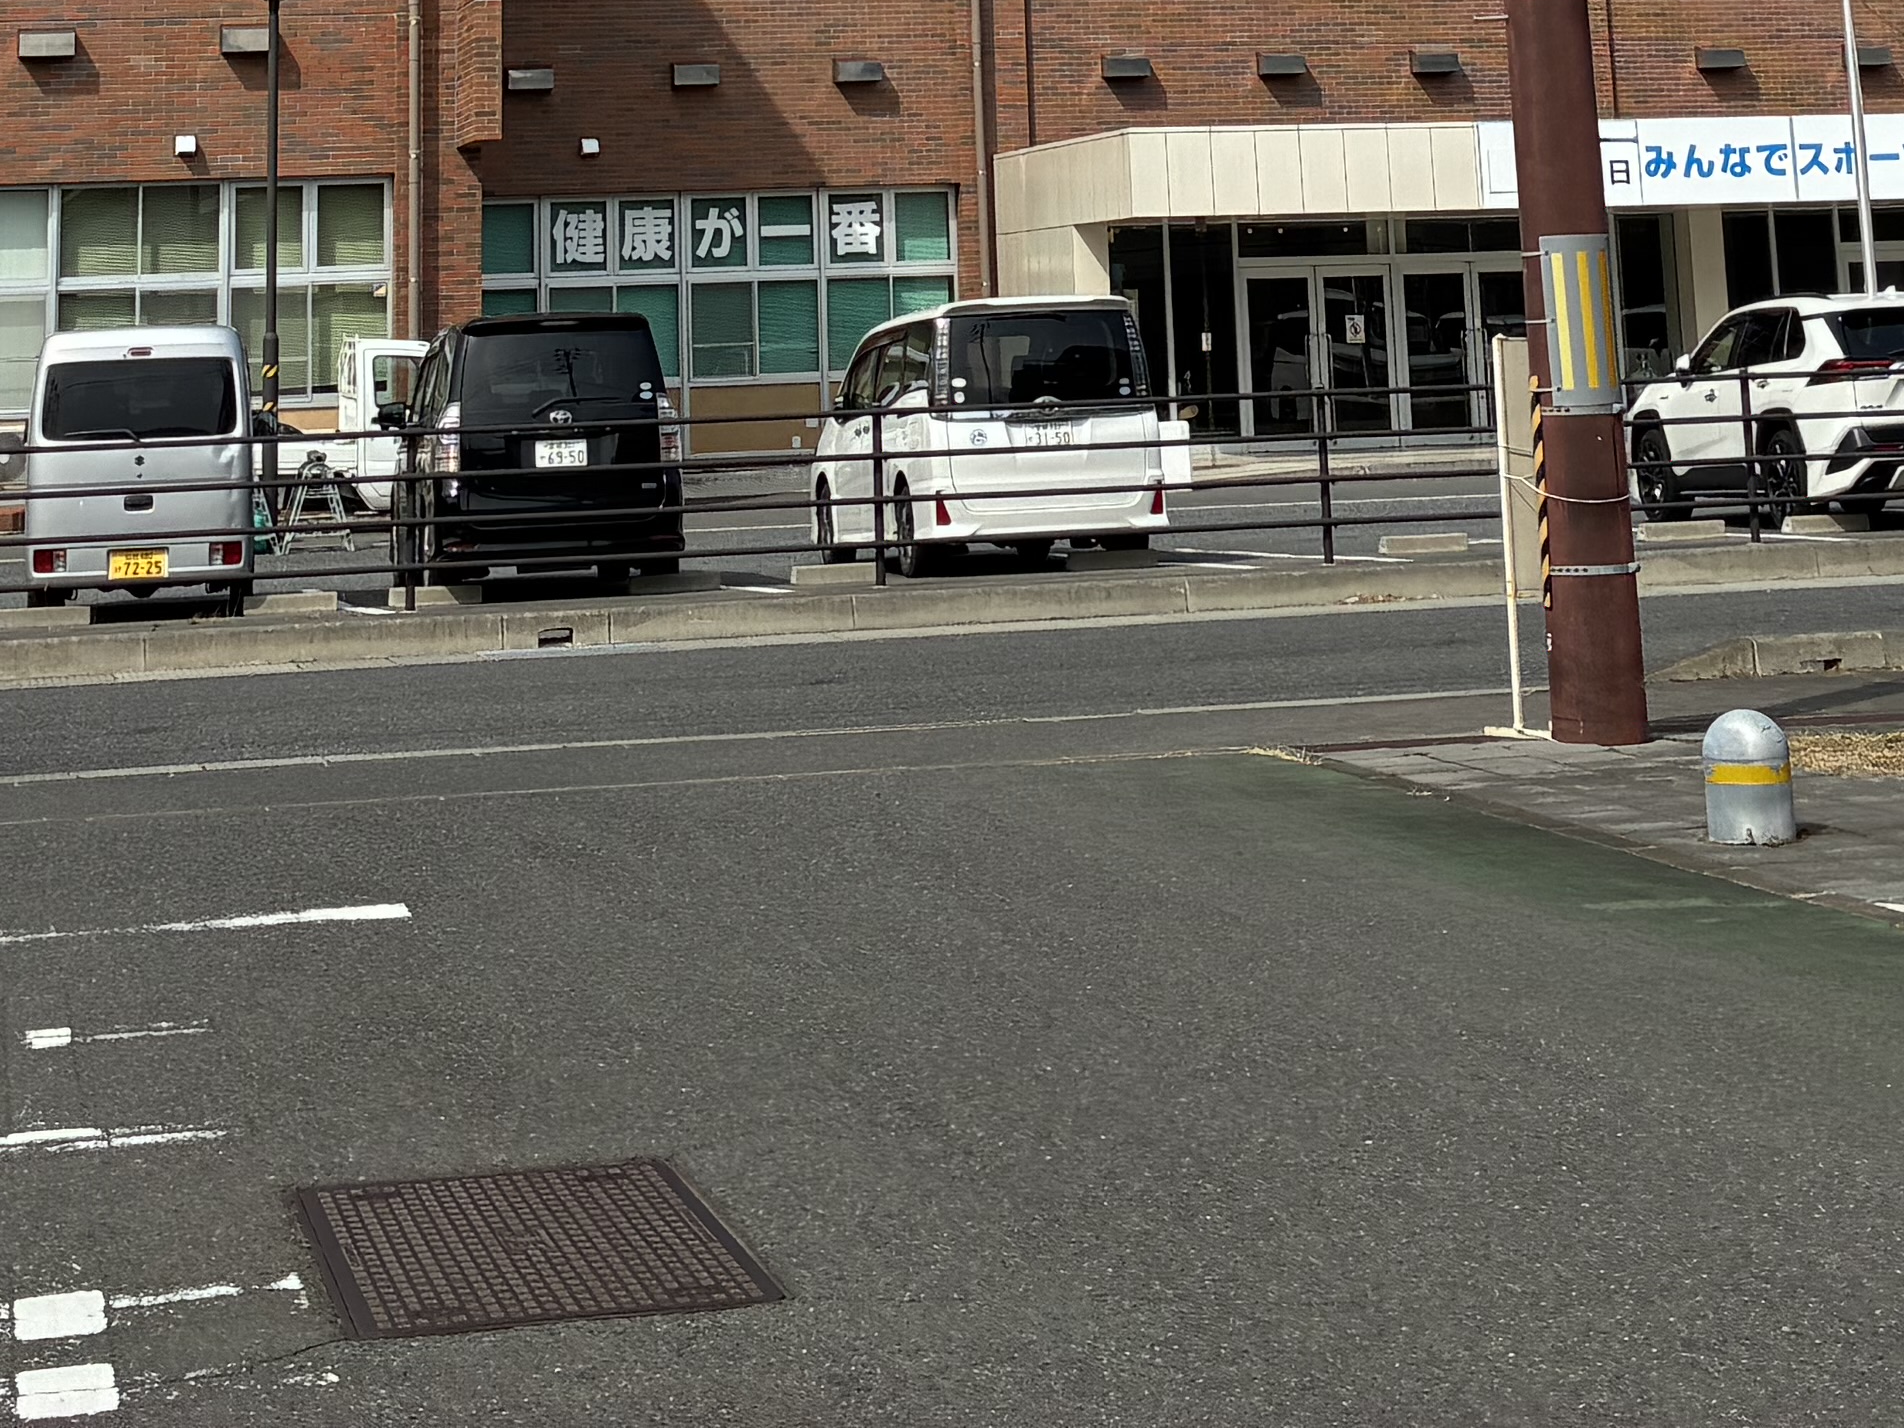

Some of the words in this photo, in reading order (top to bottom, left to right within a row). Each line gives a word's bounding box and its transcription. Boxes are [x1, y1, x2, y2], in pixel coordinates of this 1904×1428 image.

[552, 201, 882, 264] 健康が一番
